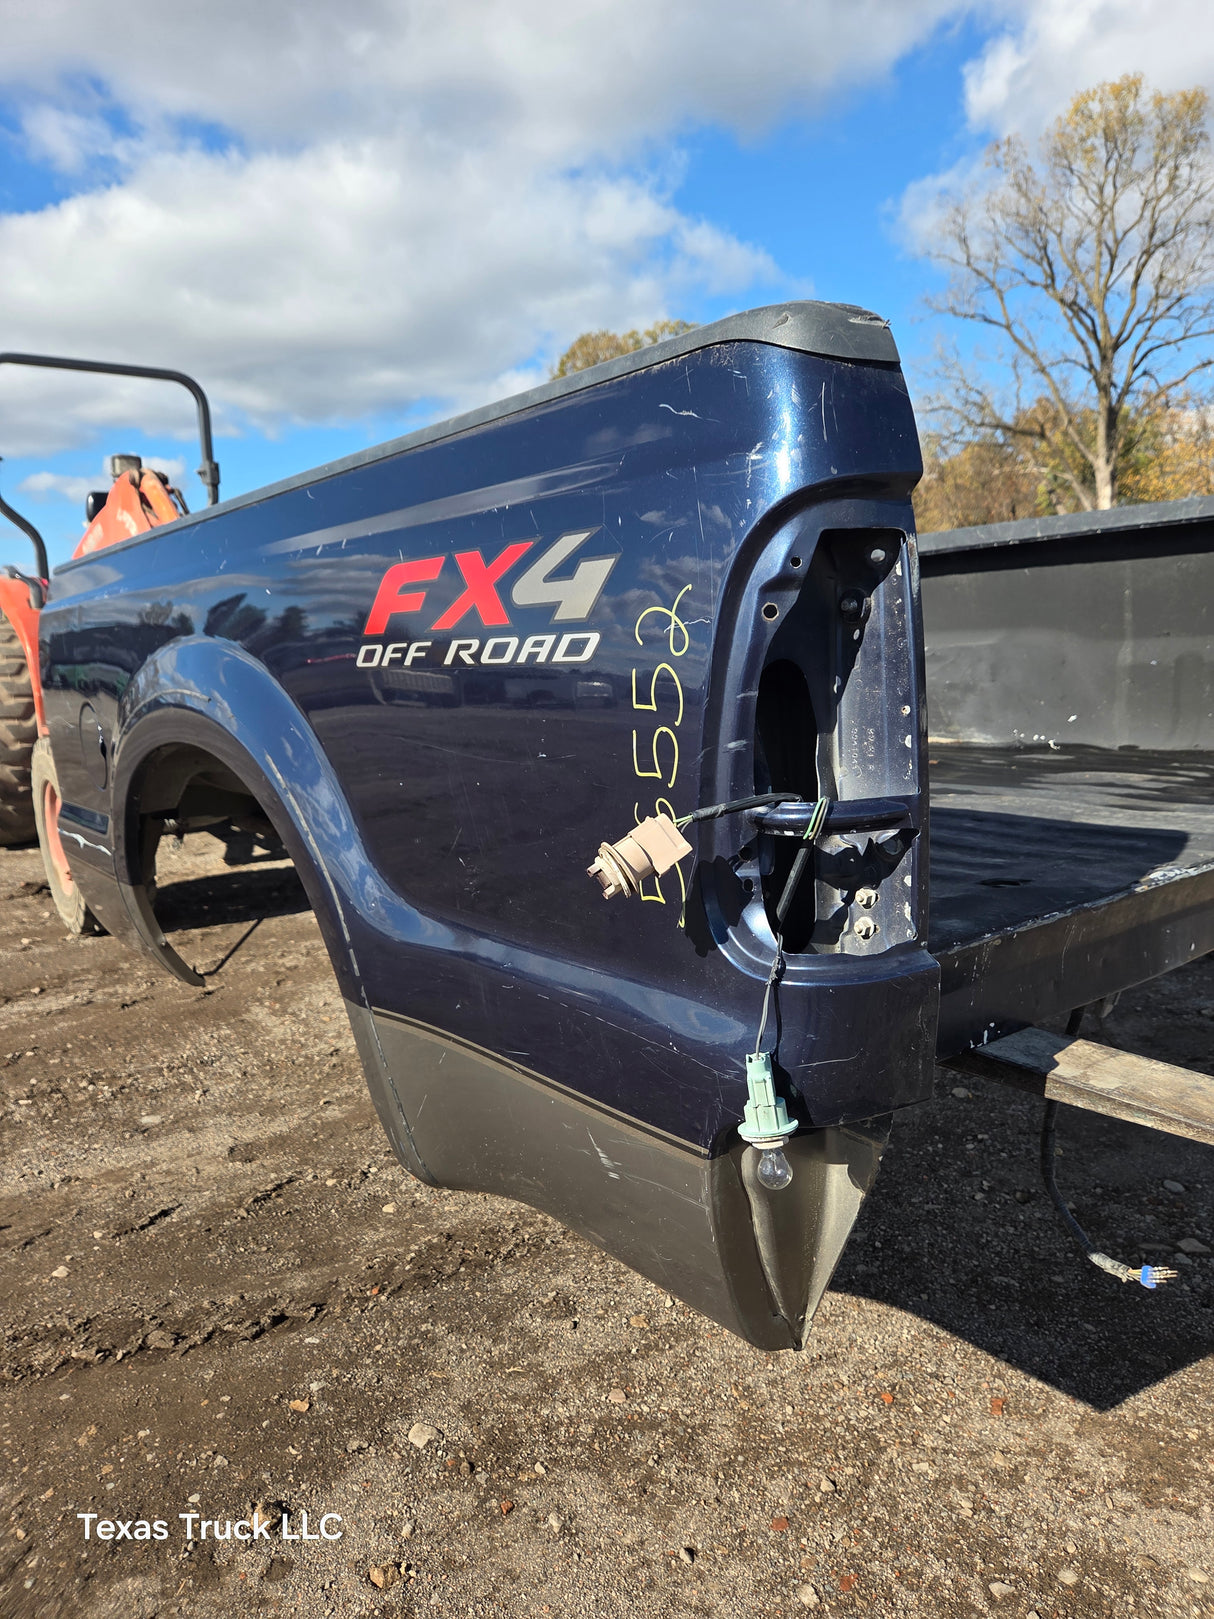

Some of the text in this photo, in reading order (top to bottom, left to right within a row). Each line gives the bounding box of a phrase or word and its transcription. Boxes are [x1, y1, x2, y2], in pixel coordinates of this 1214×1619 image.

[363, 531, 617, 636] FX4
[356, 632, 601, 668] OFF ROAD
